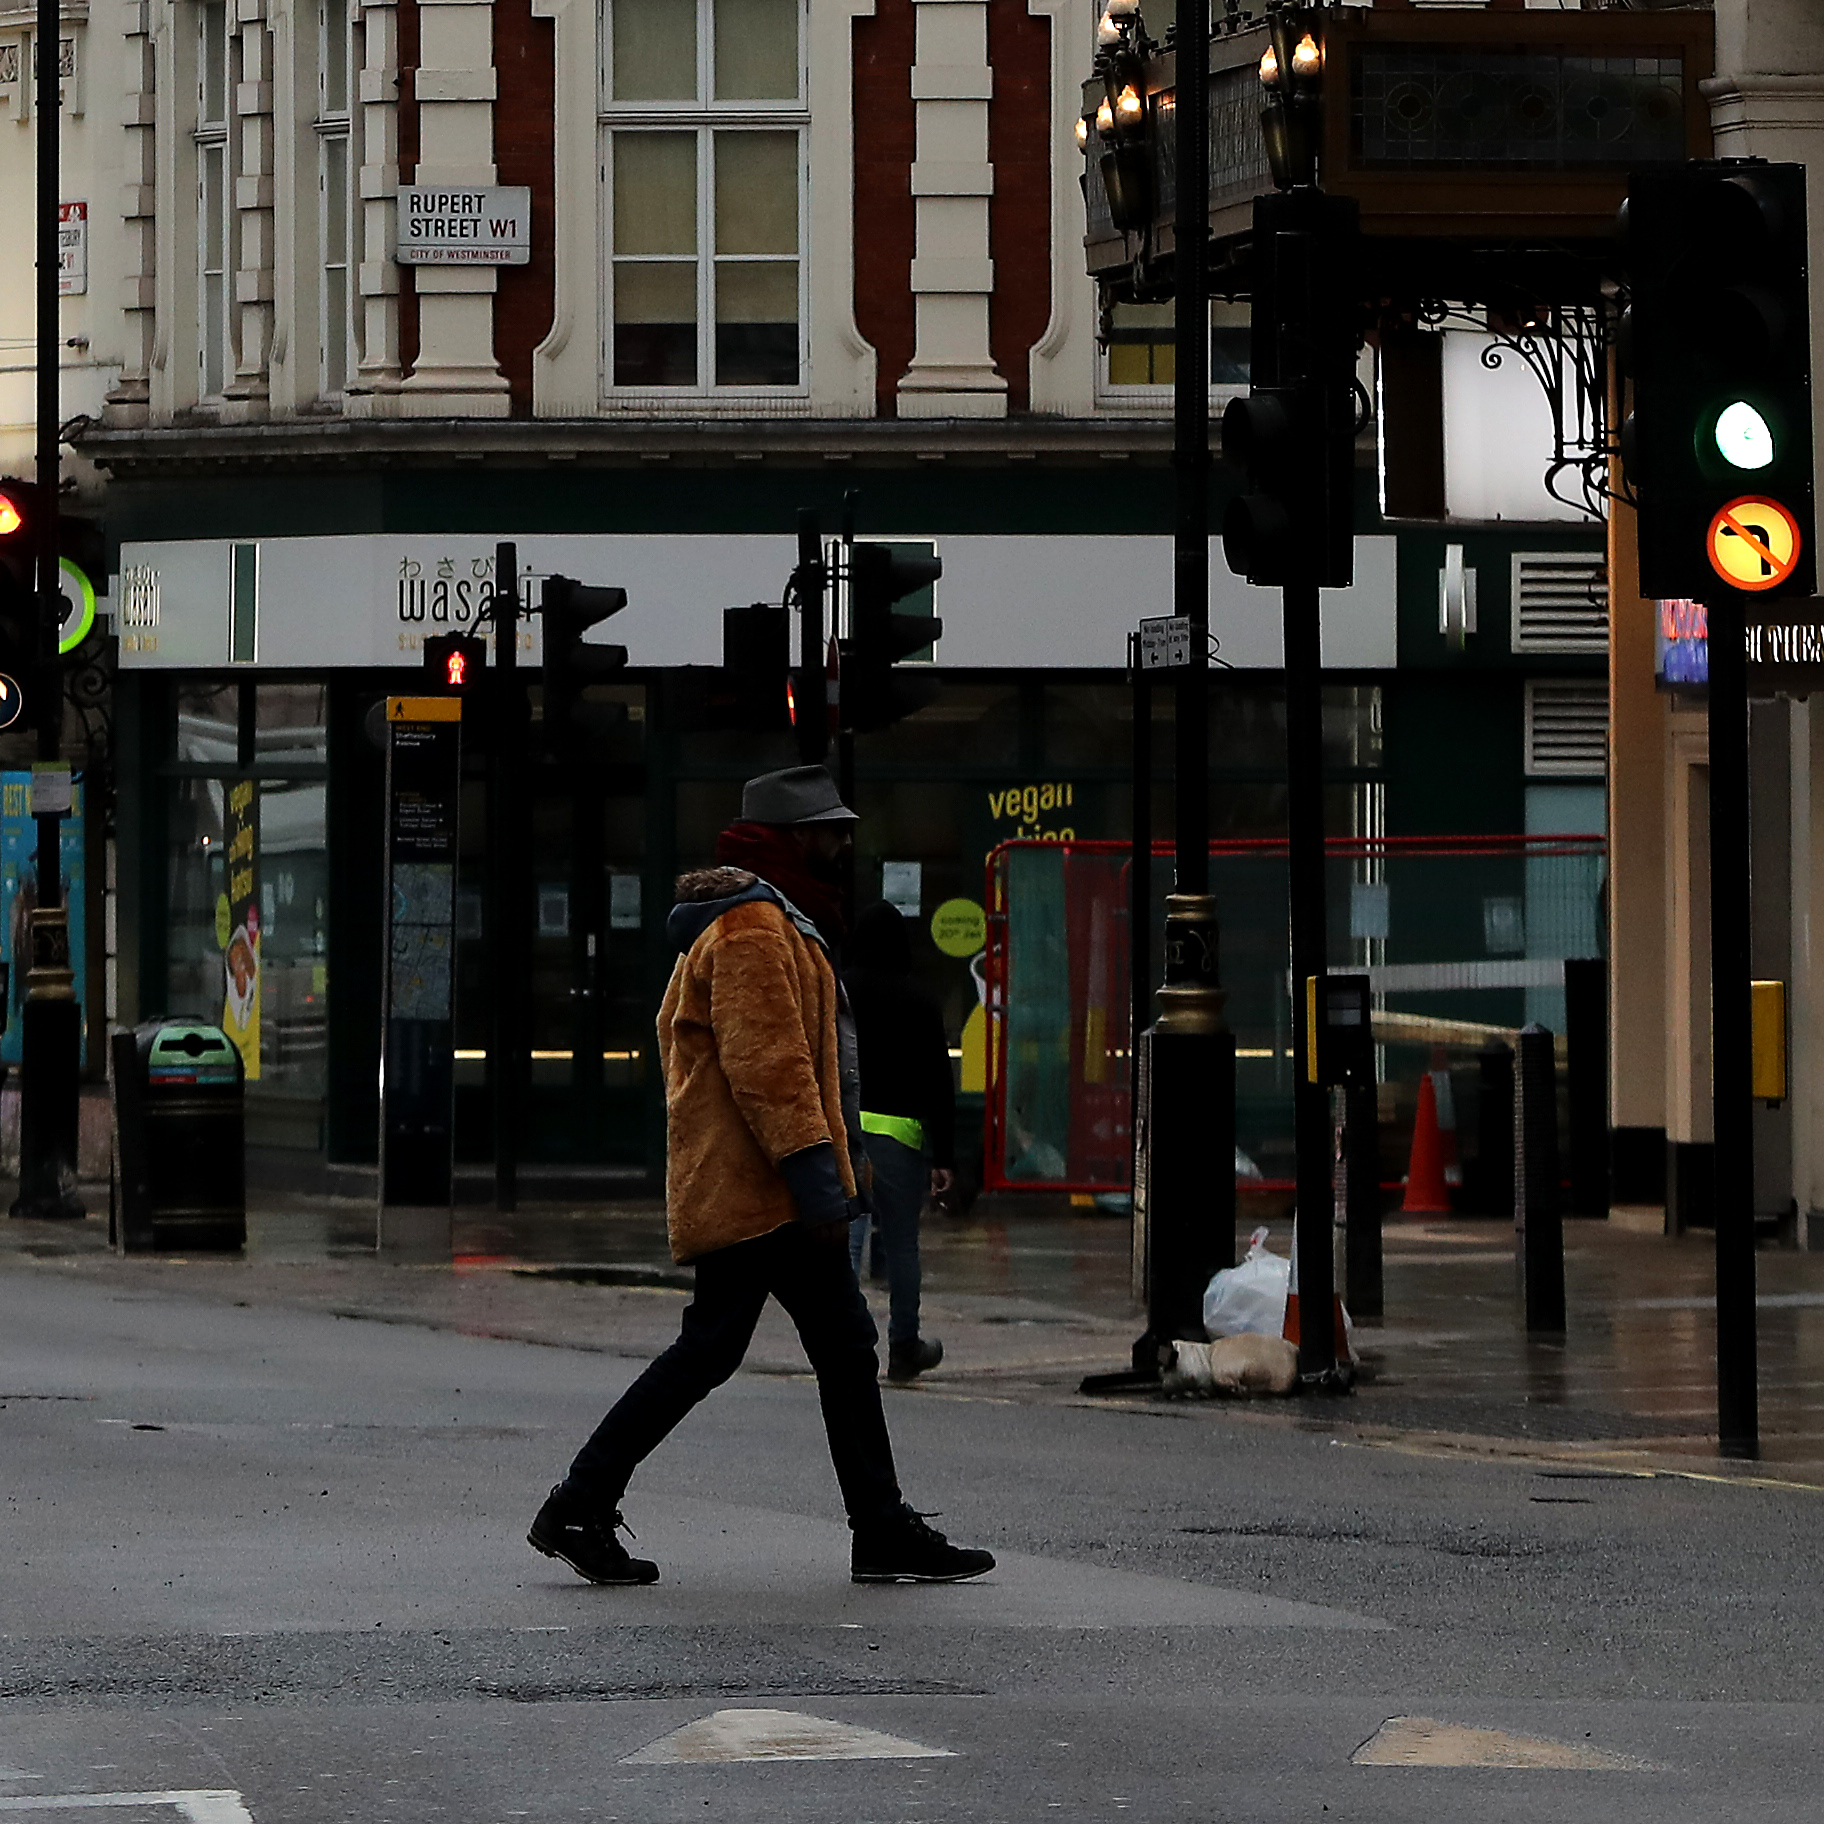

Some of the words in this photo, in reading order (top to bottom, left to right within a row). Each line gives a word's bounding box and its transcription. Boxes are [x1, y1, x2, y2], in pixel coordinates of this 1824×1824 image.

[410, 194, 486, 213] RUPERT
[410, 218, 482, 237] STREET
[489, 219, 516, 238] W1
[410, 250, 430, 259] CITY
[433, 250, 443, 259] OF
[447, 250, 511, 259] WESTMINSTER
[398, 565, 532, 622] wasai
[988, 782, 1074, 825] vegan
